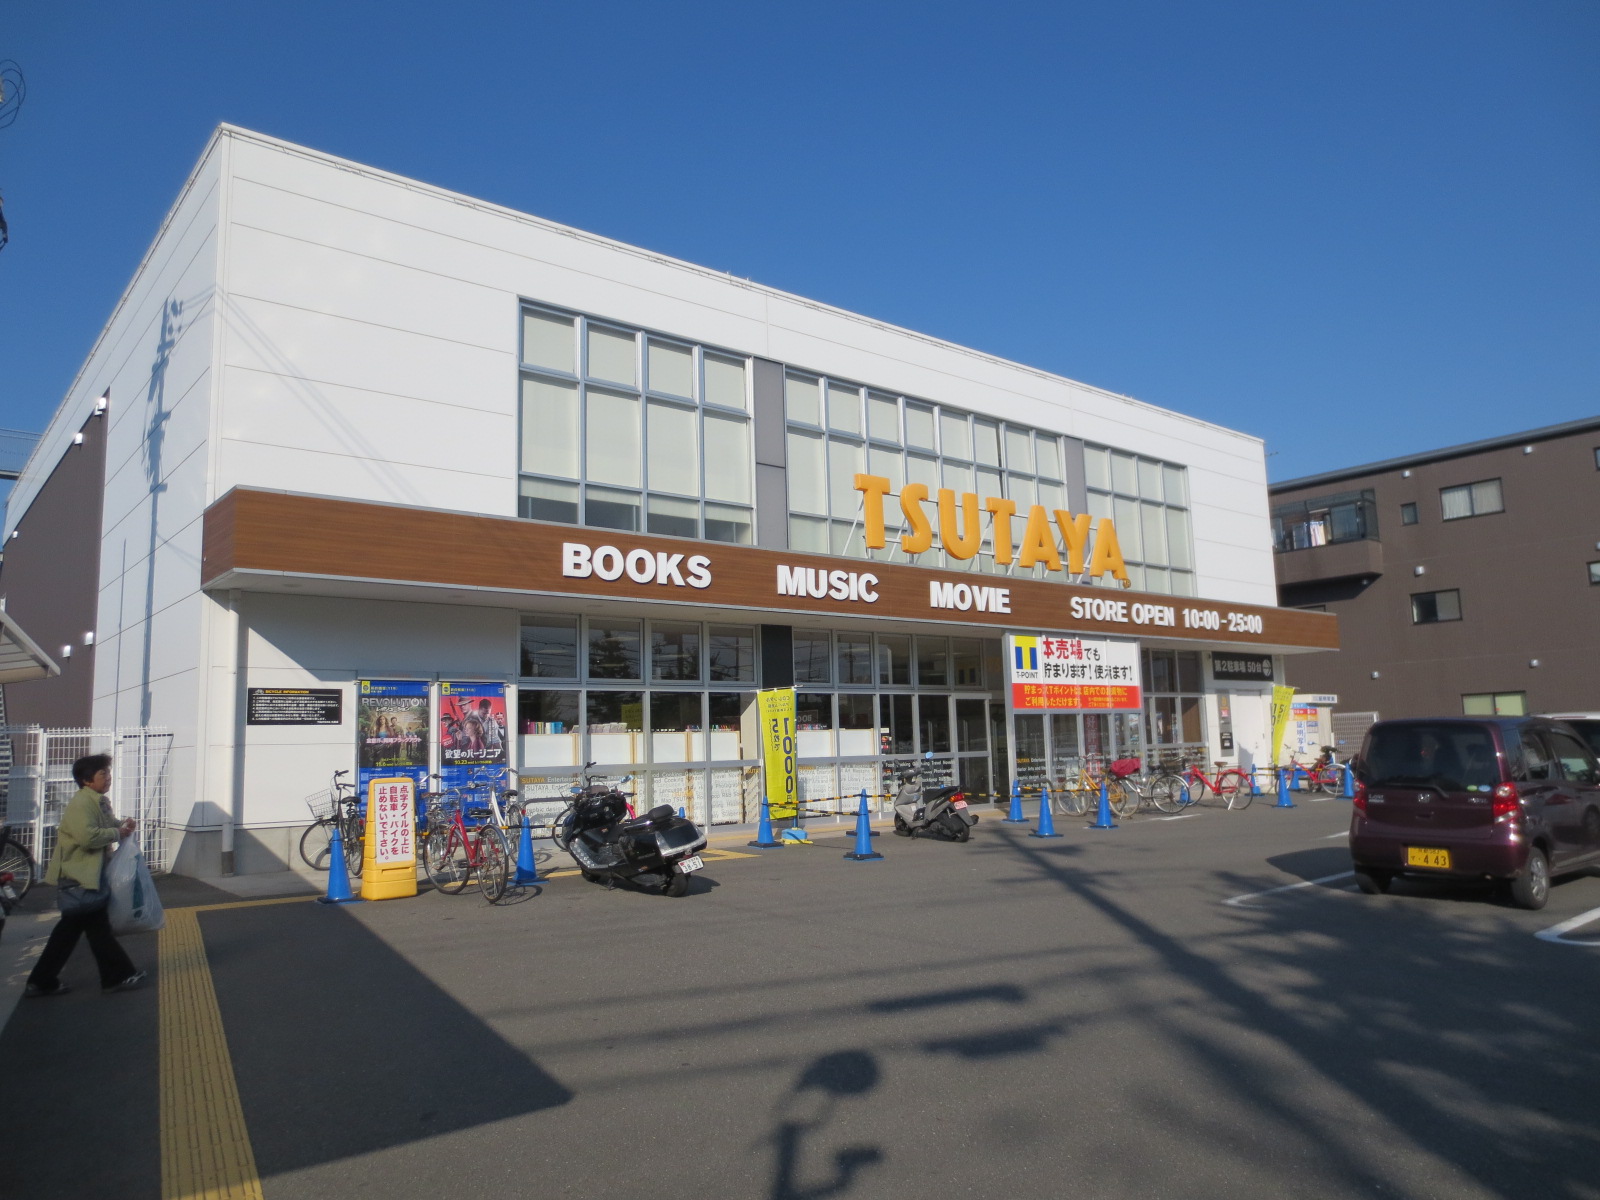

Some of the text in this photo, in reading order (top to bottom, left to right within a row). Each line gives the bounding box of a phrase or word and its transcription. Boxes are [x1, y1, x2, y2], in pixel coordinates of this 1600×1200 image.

[854, 473, 1128, 581] TSUTAYA
[562, 542, 712, 589] BOOKS
[777, 564, 879, 603] MUSIC
[929, 581, 1011, 614] MOVIE
[1070, 596, 1128, 623] STORE
[1135, 602, 1175, 627] OPEN
[1042, 637, 1101, 661] 本売場でも
[445, 748, 502, 759] 欲望のバージニア
[378, 786, 389, 860] 止めないで下さい。
[389, 786, 399, 855] 自転車・バイクを
[400, 785, 409, 854] 点字タイルの上に
